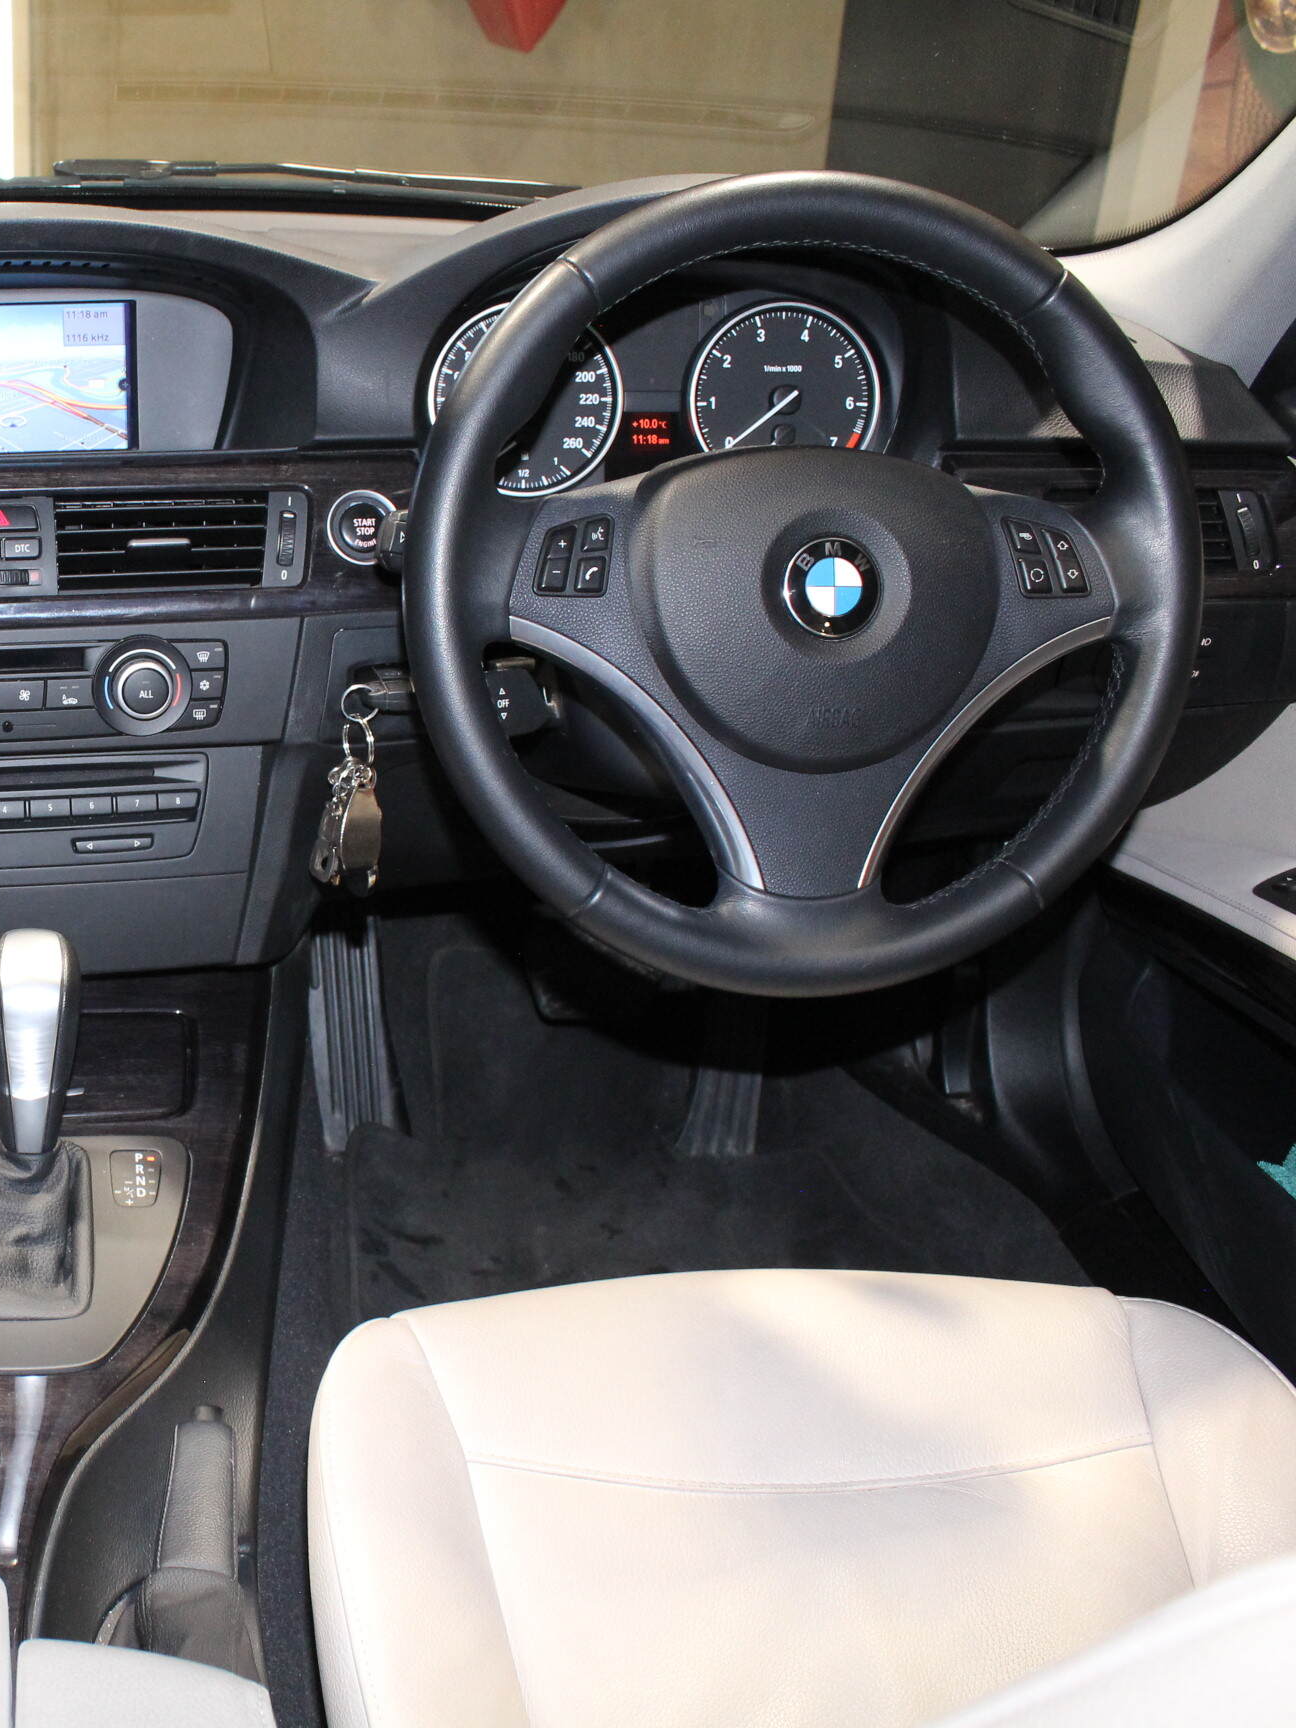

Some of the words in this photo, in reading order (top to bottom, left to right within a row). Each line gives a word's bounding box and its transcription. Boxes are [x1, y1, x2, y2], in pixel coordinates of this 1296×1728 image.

[66, 310, 91, 319] 11:18
[66, 334, 88, 342] 1116
[91, 333, 109, 342] kHz
[757, 329, 766, 342] 3
[801, 329, 810, 342] 4
[722, 354, 731, 368] 2
[834, 355, 843, 368] 5
[764, 364, 782, 372] 1/min
[787, 364, 802, 372] 1000
[575, 371, 596, 382] 200
[579, 393, 600, 405] 220
[709, 396, 716, 409] 1
[846, 396, 854, 409] 6
[574, 416, 596, 428] 240
[632, 418, 658, 429] +10.0
[563, 437, 584, 449] 260
[632, 434, 658, 444] 11:18
[829, 436, 838, 447] 7
[553, 457, 558, 465] 1
[518, 469, 529, 477] 1/2
[353, 518, 376, 527] START
[356, 527, 375, 536] STOP
[14, 543, 31, 553] DTC
[795, 541, 870, 572] BMW
[138, 689, 154, 699] ALL
[497, 699, 510, 708] OFF
[2, 805, 7, 813] 4
[47, 803, 53, 811] 5
[89, 801, 95, 809] 6
[135, 799, 140, 807] 7
[175, 797, 181, 805] 8
[134, 1153, 143, 1162] P
[135, 1164, 144, 1174] R
[135, 1176, 146, 1186] N
[136, 1187, 146, 1198] D
